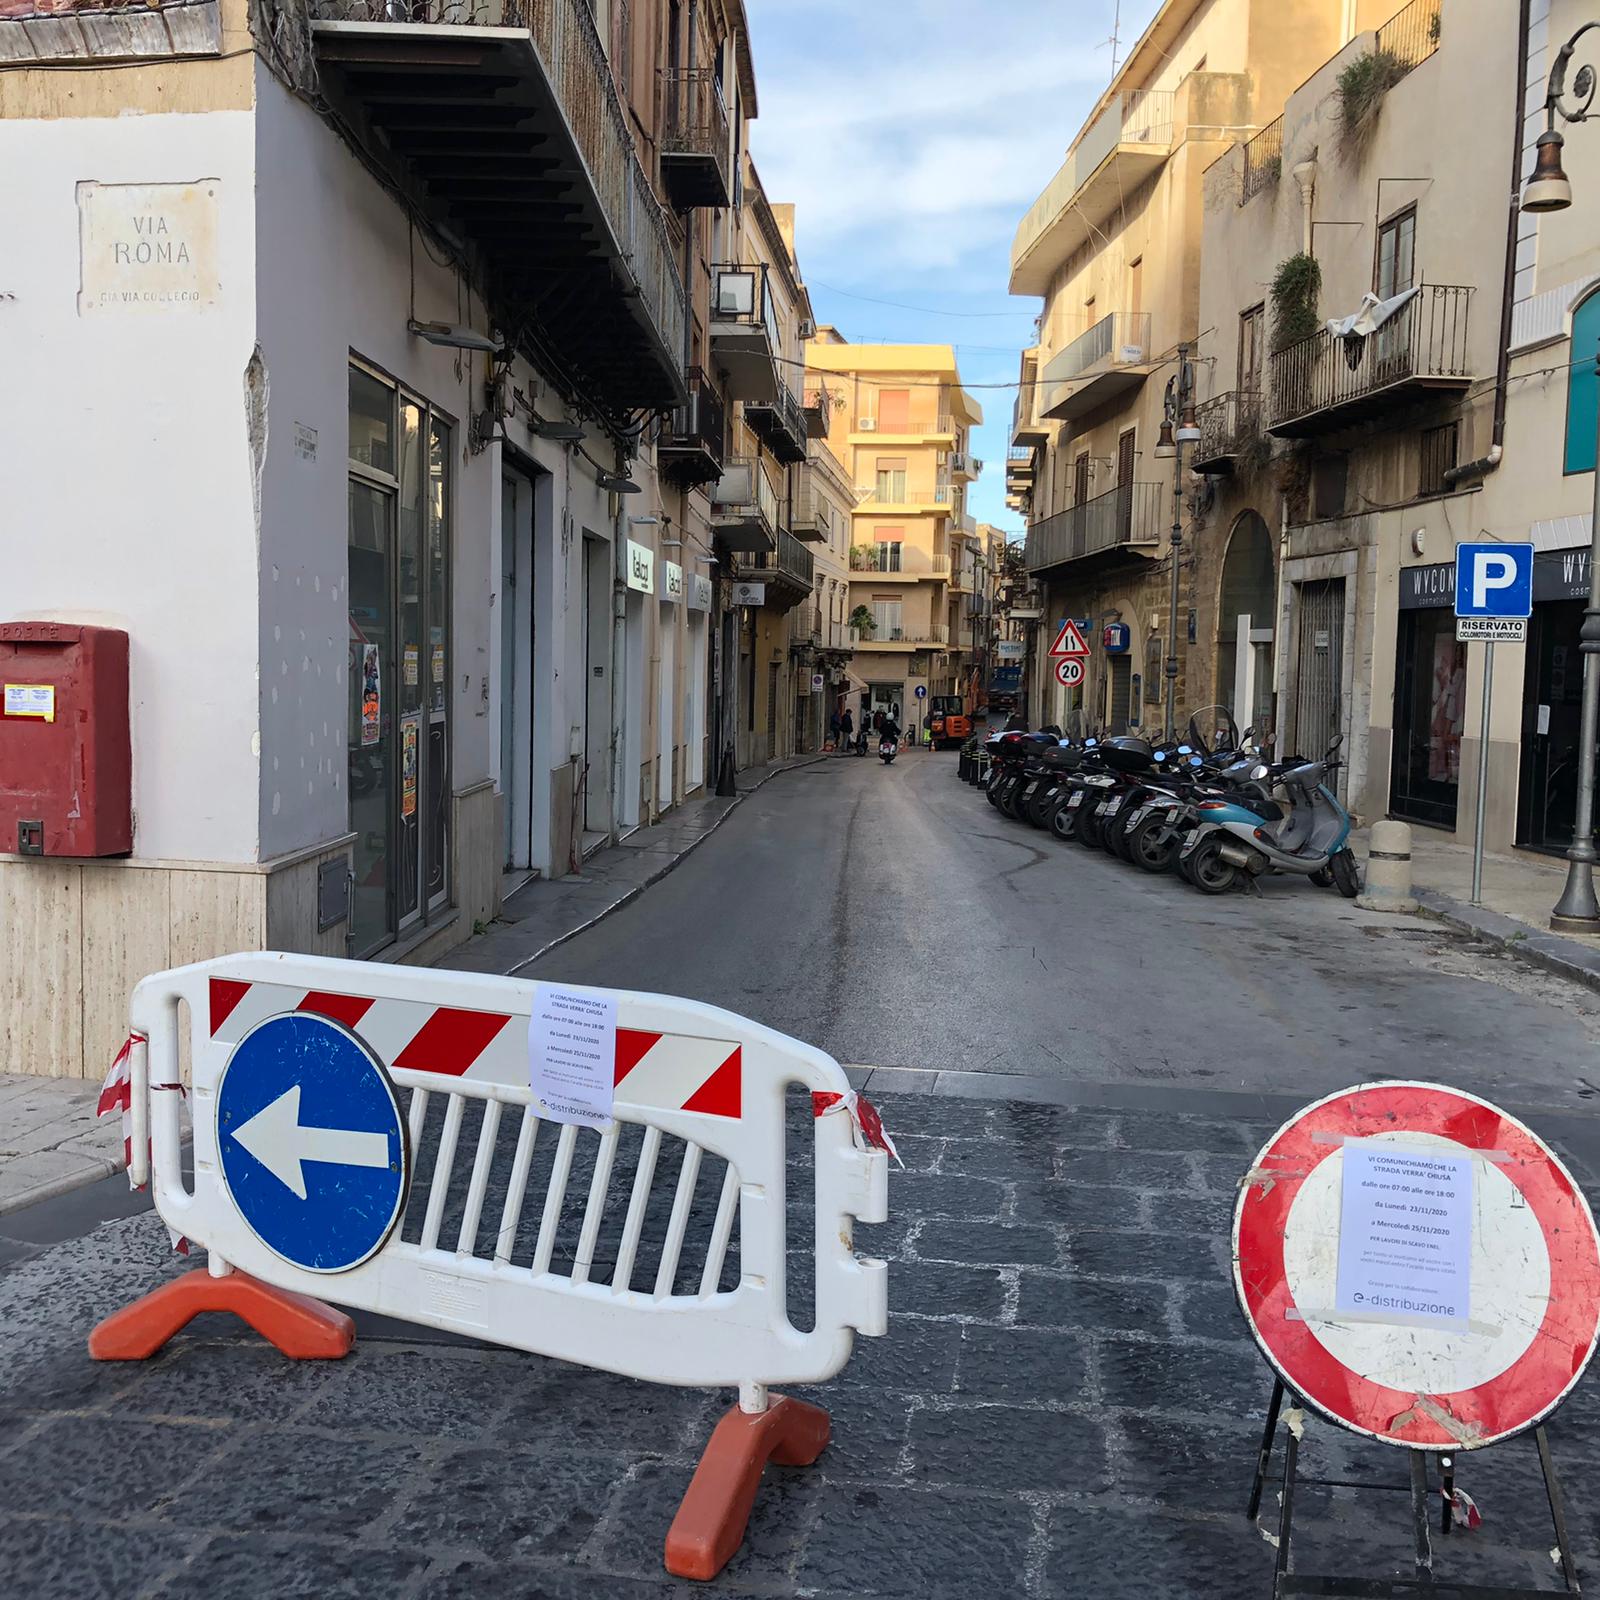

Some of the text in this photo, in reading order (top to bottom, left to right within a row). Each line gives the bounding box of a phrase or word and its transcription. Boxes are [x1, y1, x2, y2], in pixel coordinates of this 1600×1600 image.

[133, 216, 168, 234] VIA
[114, 242, 190, 264] ROMA
[122, 292, 140, 302] VIA
[1563, 552, 1592, 584] WY
[1414, 568, 1454, 594] WYCON
[1472, 552, 1518, 608] P
[3, 626, 60, 640] POSTE
[1462, 622, 1522, 630] RISERVATO
[1062, 665, 1079, 678] 20
[1377, 1157, 1432, 1169] COMUNICHIAMO
[1374, 1166, 1400, 1175] STRADA
[1428, 1173, 1451, 1181] CHIUSA
[1361, 1180, 1378, 1188] dalle
[1410, 1206, 1448, 1217] 23/11/2020
[1412, 1224, 1450, 1236] 25/11/2020
[1354, 1292, 1455, 1316] e-distribuzione
